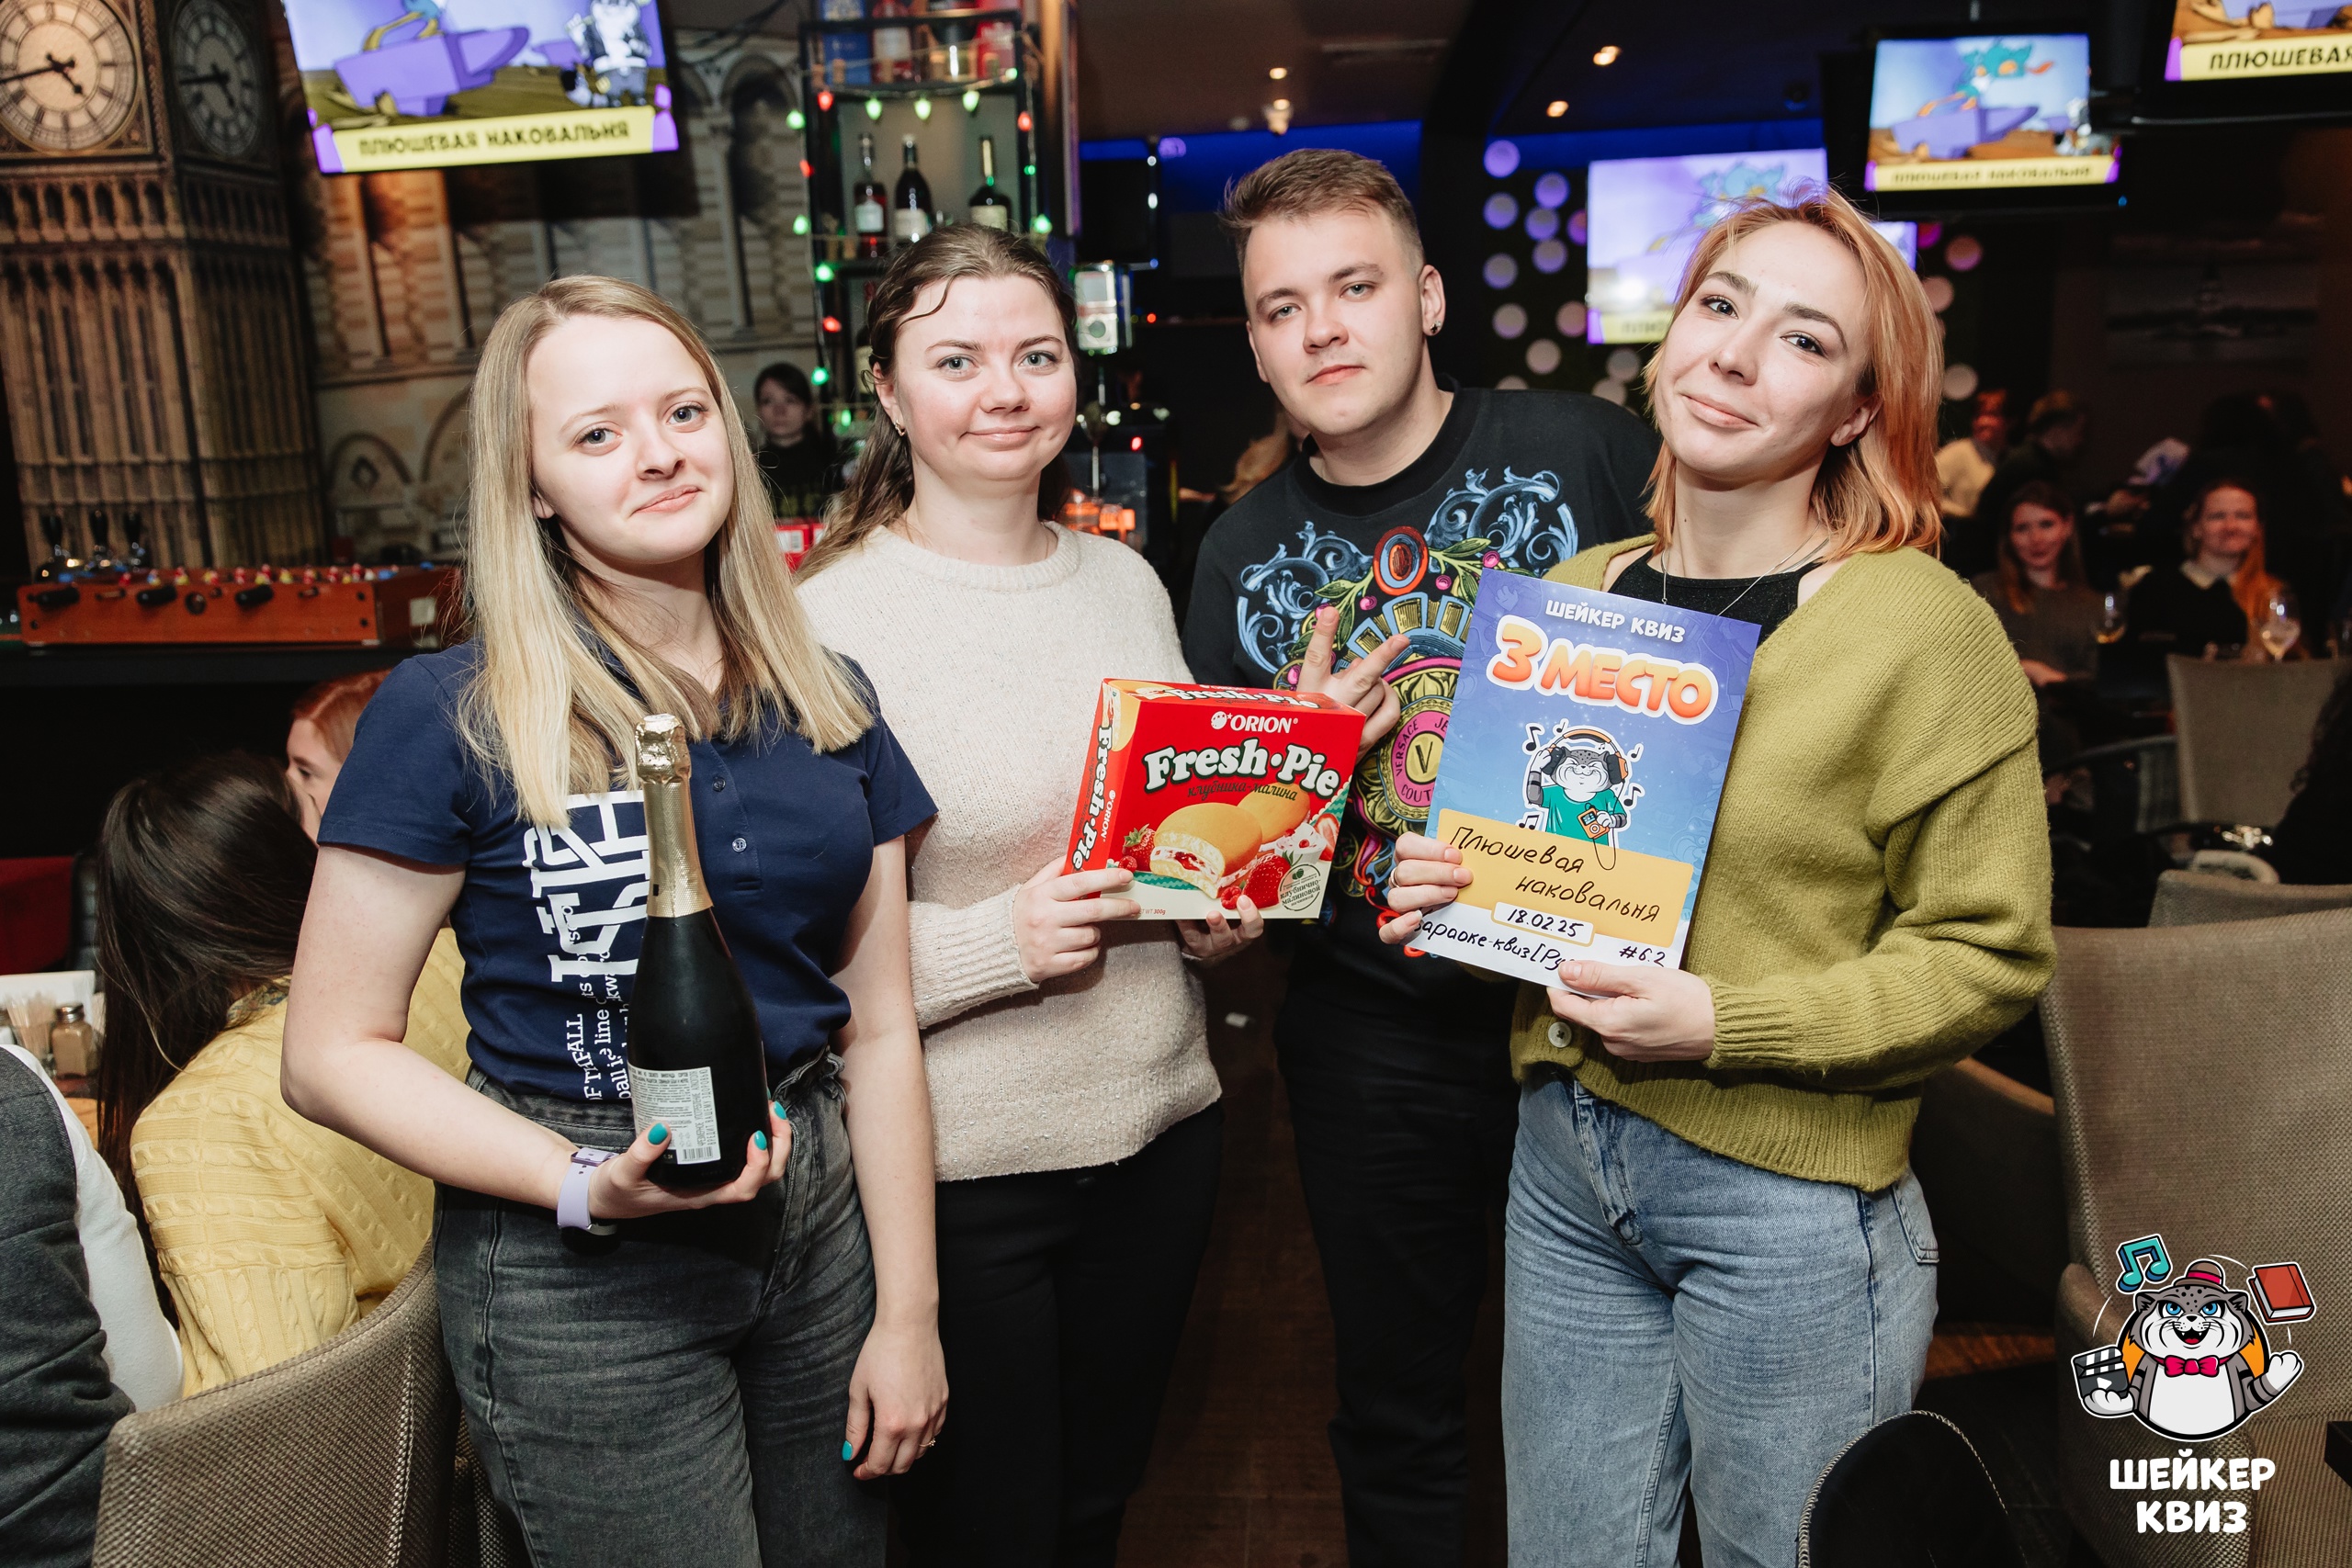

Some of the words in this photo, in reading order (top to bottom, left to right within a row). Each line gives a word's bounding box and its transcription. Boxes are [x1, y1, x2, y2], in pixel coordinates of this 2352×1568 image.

[359, 132, 480, 155] ПЛЮШЕВАЯ
[487, 121, 630, 147] НАКОВАЛЬНЯ
[1544, 600, 1625, 630] ШЕЙКЕР
[1630, 617, 1686, 643] КВИЗ
[1540, 644, 1713, 719] МЕСТО
[1395, 719, 1419, 777] VERSACE
[1434, 717, 1449, 732] JE
[1415, 741, 1433, 774] V
[1187, 781, 1298, 801] клубника-малина
[1401, 784, 1434, 803] COUT
[1450, 827, 1585, 874] Плюшевая
[1282, 885, 1321, 906] малиновой
[1514, 875, 1660, 922] наковальня
[1507, 908, 1585, 938] 18.02.25
[1619, 945, 1668, 968] #6.2
[594, 1009, 612, 1044] line
[703, 1101, 714, 1123] ВАШЕМУ
[705, 1125, 717, 1145] ВРЕДИТ
